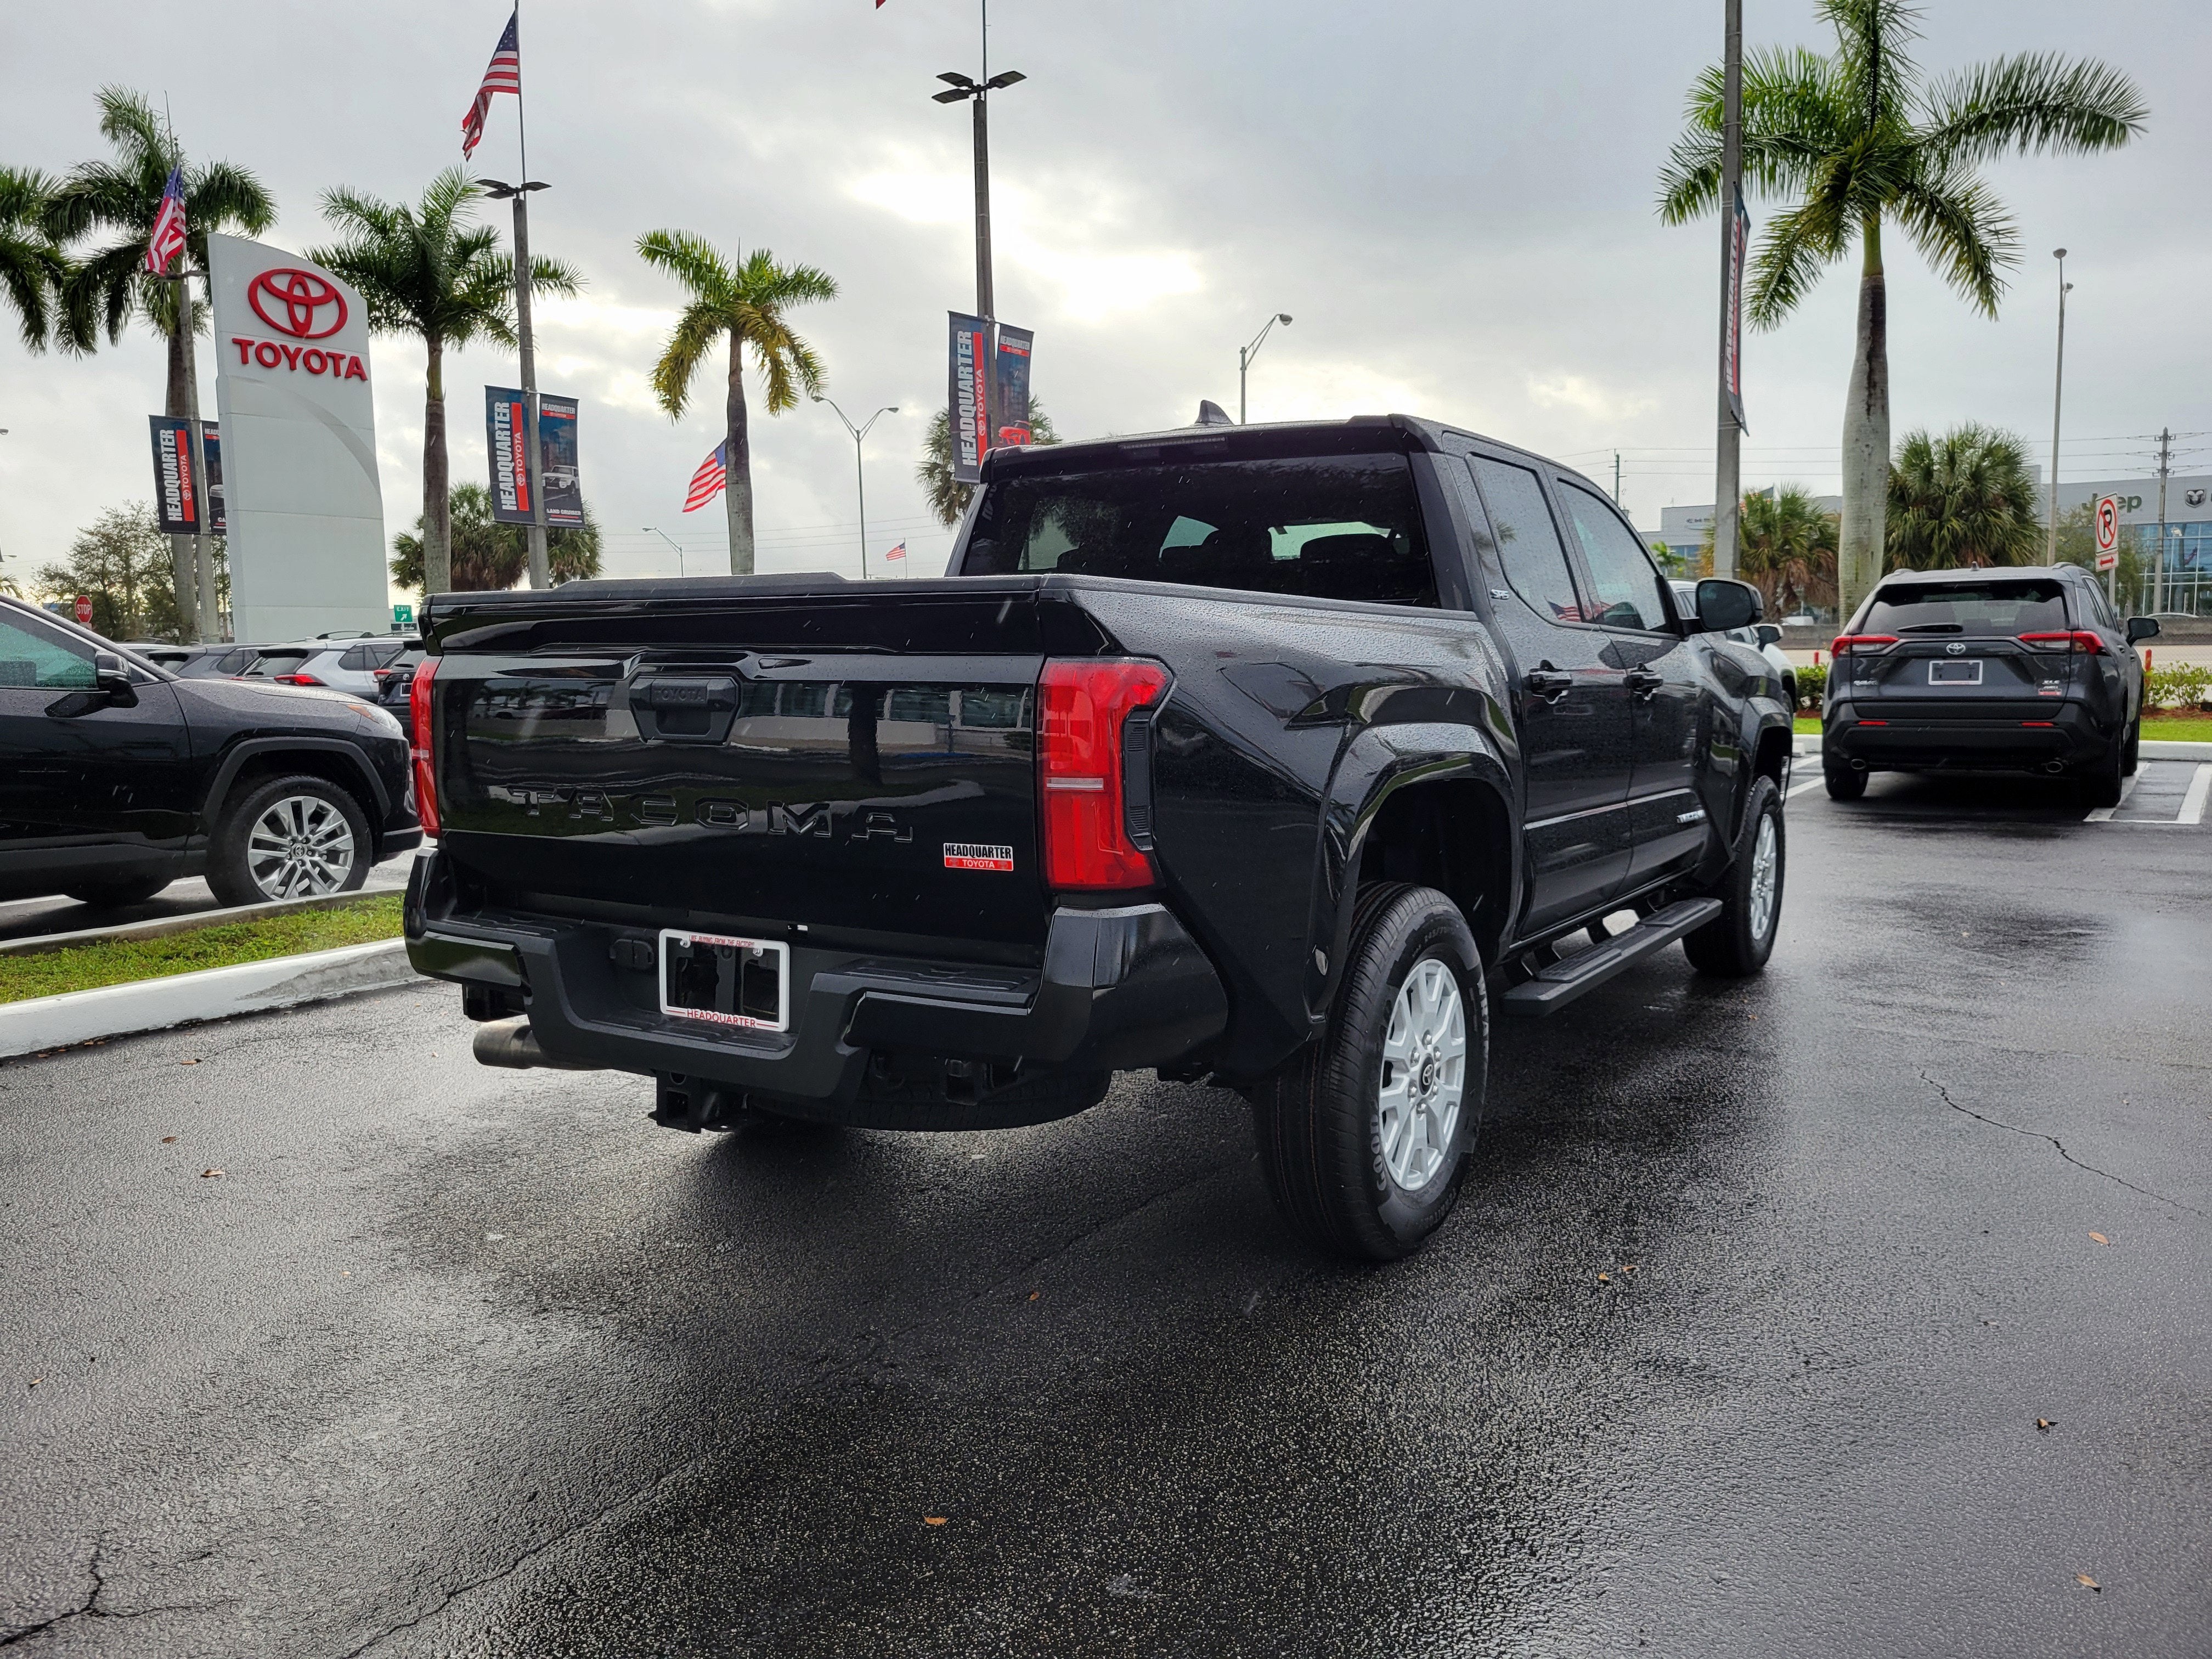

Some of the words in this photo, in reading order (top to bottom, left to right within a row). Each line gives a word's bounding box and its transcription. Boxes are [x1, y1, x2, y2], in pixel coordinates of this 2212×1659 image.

[232, 337, 369, 381] TOYOTA
[956, 330, 978, 466] HEADQUARTER
[975, 369, 984, 419] TOYOTA
[180, 454, 190, 489] TOYOTA
[494, 401, 518, 511] HEADQUARTER
[514, 432, 525, 472] TOYOTA
[160, 429, 183, 521] HEADQUARTER
[77, 604, 91, 614] STOP
[655, 687, 704, 702] TOYOTA
[507, 784, 913, 843] TACOMA
[945, 844, 1012, 859] HEADQUARTER
[962, 859, 995, 868] TOYOTA
[687, 1009, 757, 1028] HEADQUARTER
